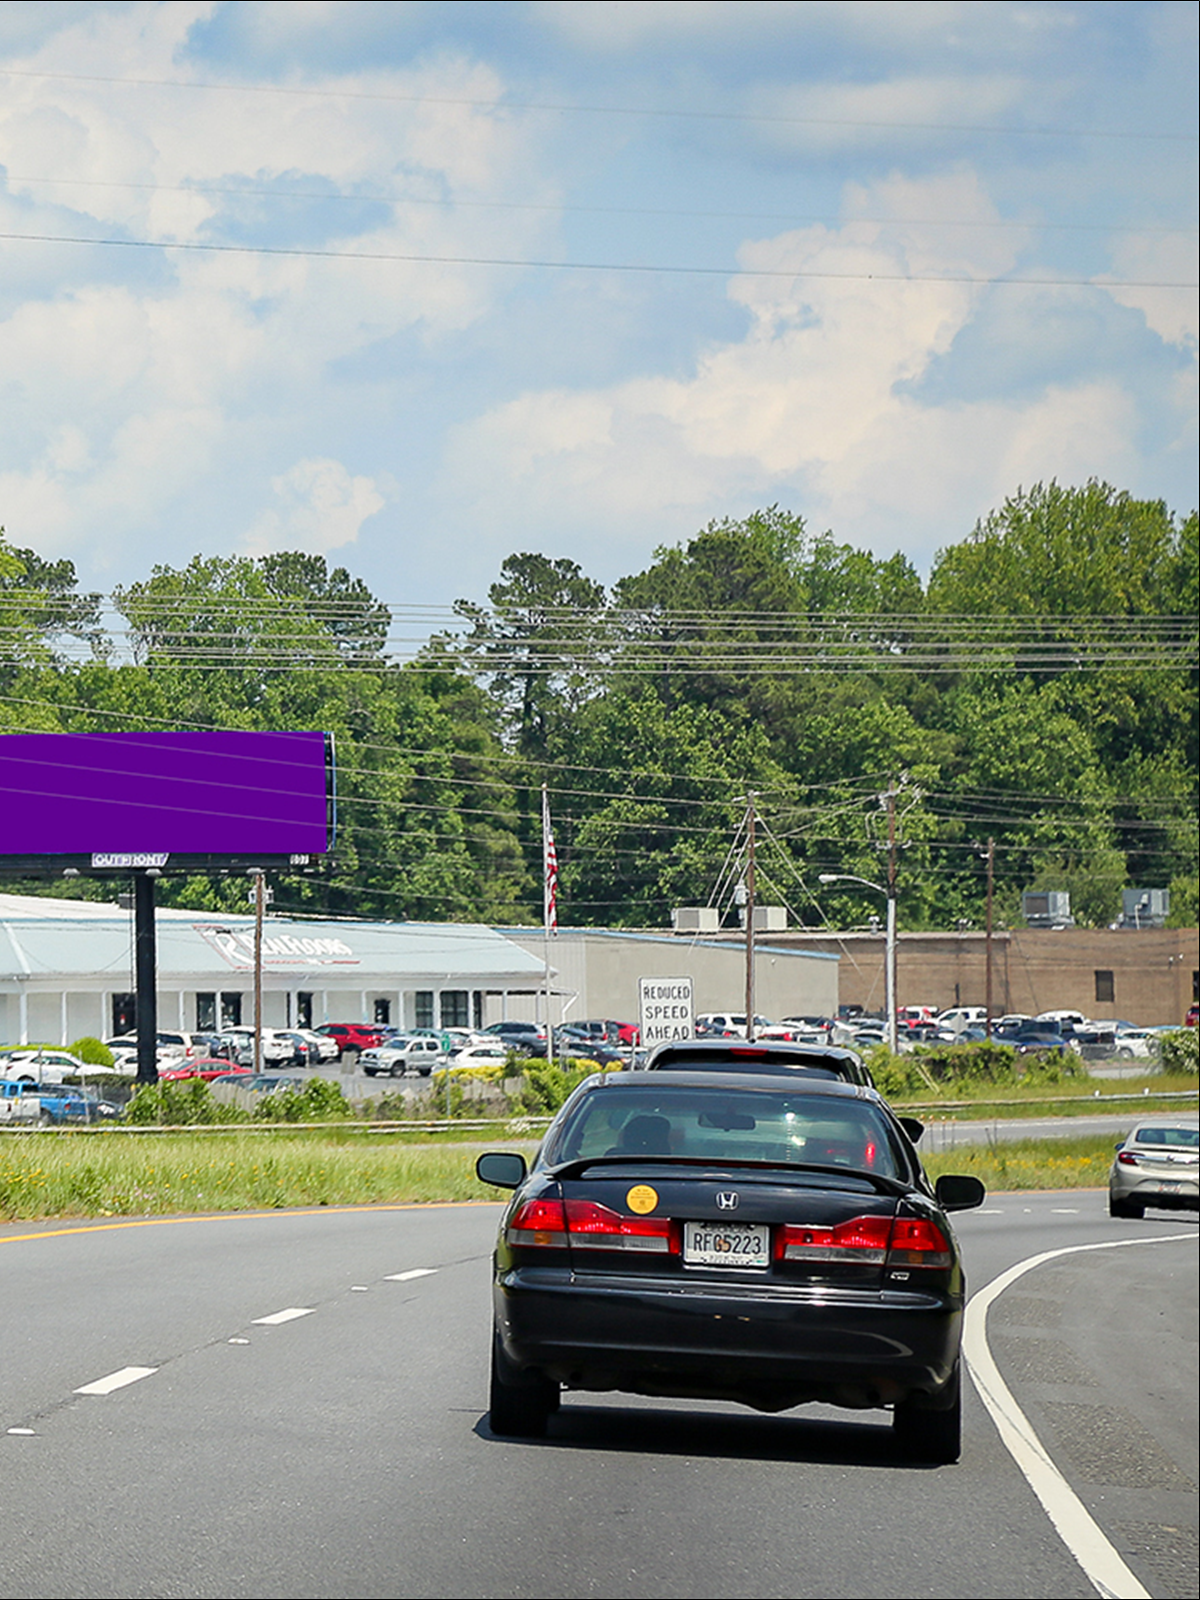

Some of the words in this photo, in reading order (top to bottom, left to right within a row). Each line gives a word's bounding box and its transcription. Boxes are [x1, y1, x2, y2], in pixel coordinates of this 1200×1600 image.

[643, 986, 690, 1000] REDUCED
[645, 1006, 689, 1020] SPEED
[646, 1025, 690, 1040] AHEAD
